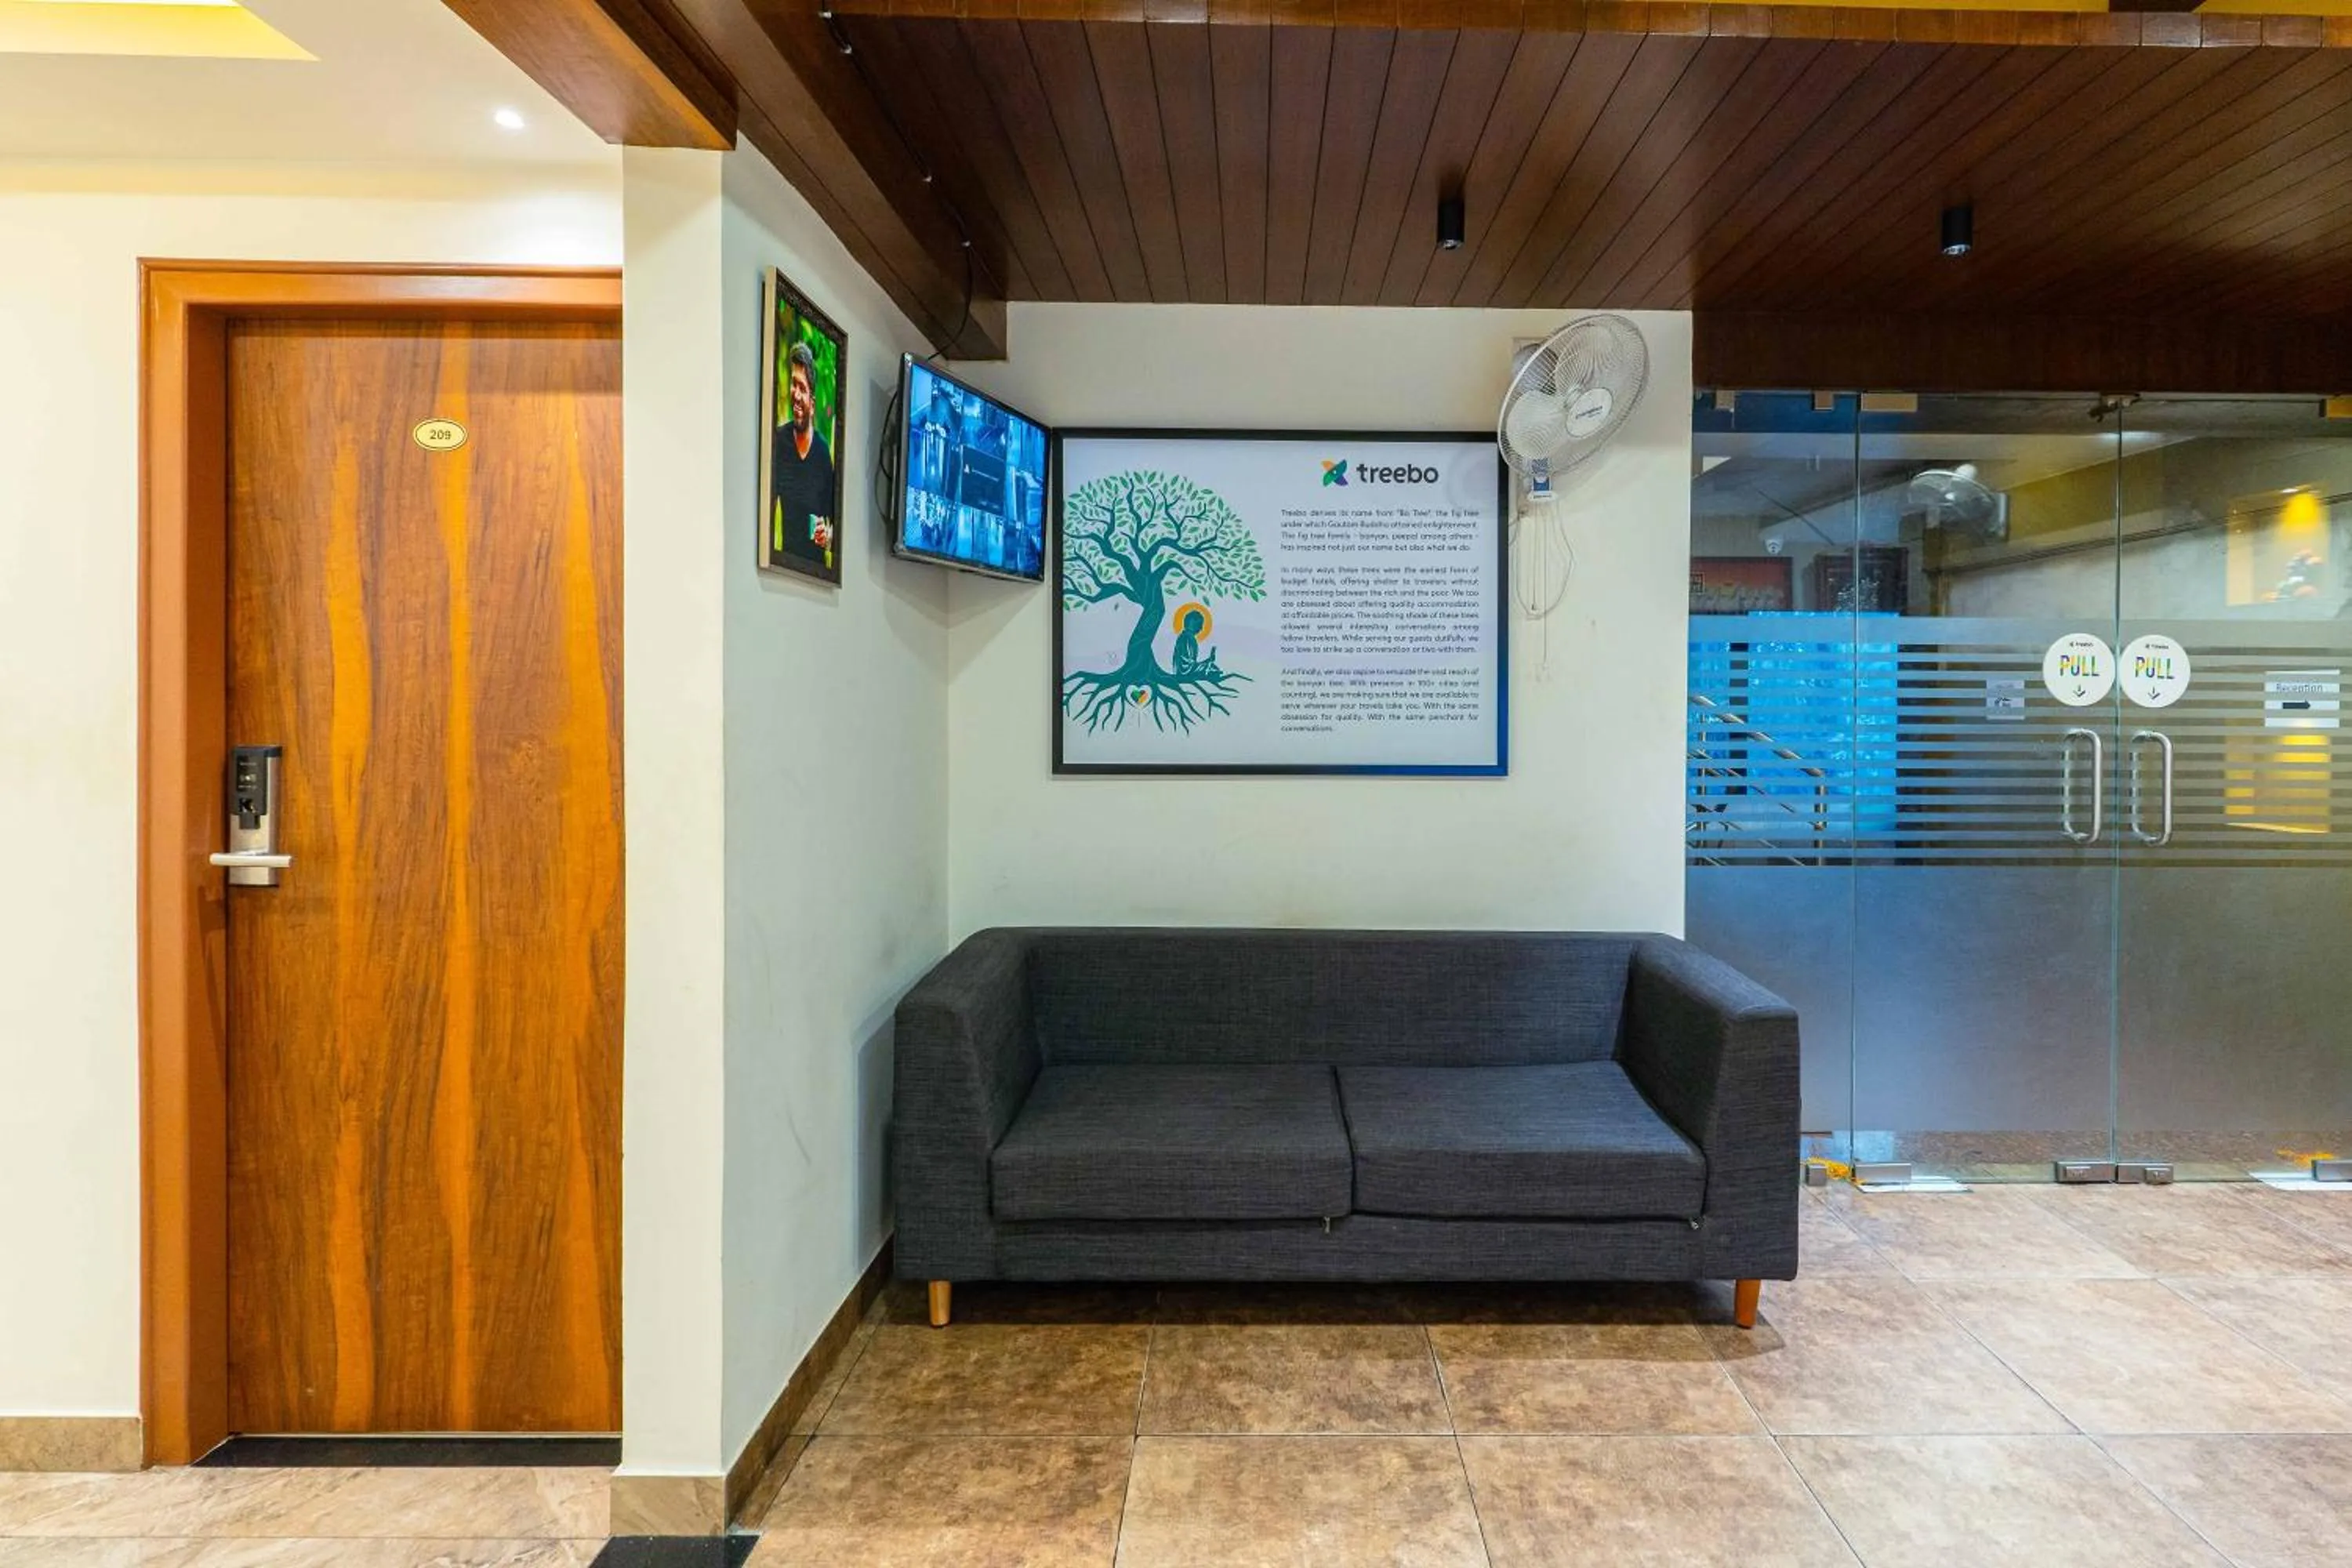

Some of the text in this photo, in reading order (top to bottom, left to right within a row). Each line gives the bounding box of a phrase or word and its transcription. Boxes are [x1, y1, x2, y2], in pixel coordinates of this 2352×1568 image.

[430, 430, 452, 440] 209
[1356, 463, 1439, 484] treebo
[2059, 655, 2100, 677] PULL
[2134, 656, 2176, 680] PULL
[2276, 682, 2323, 694] Reception
